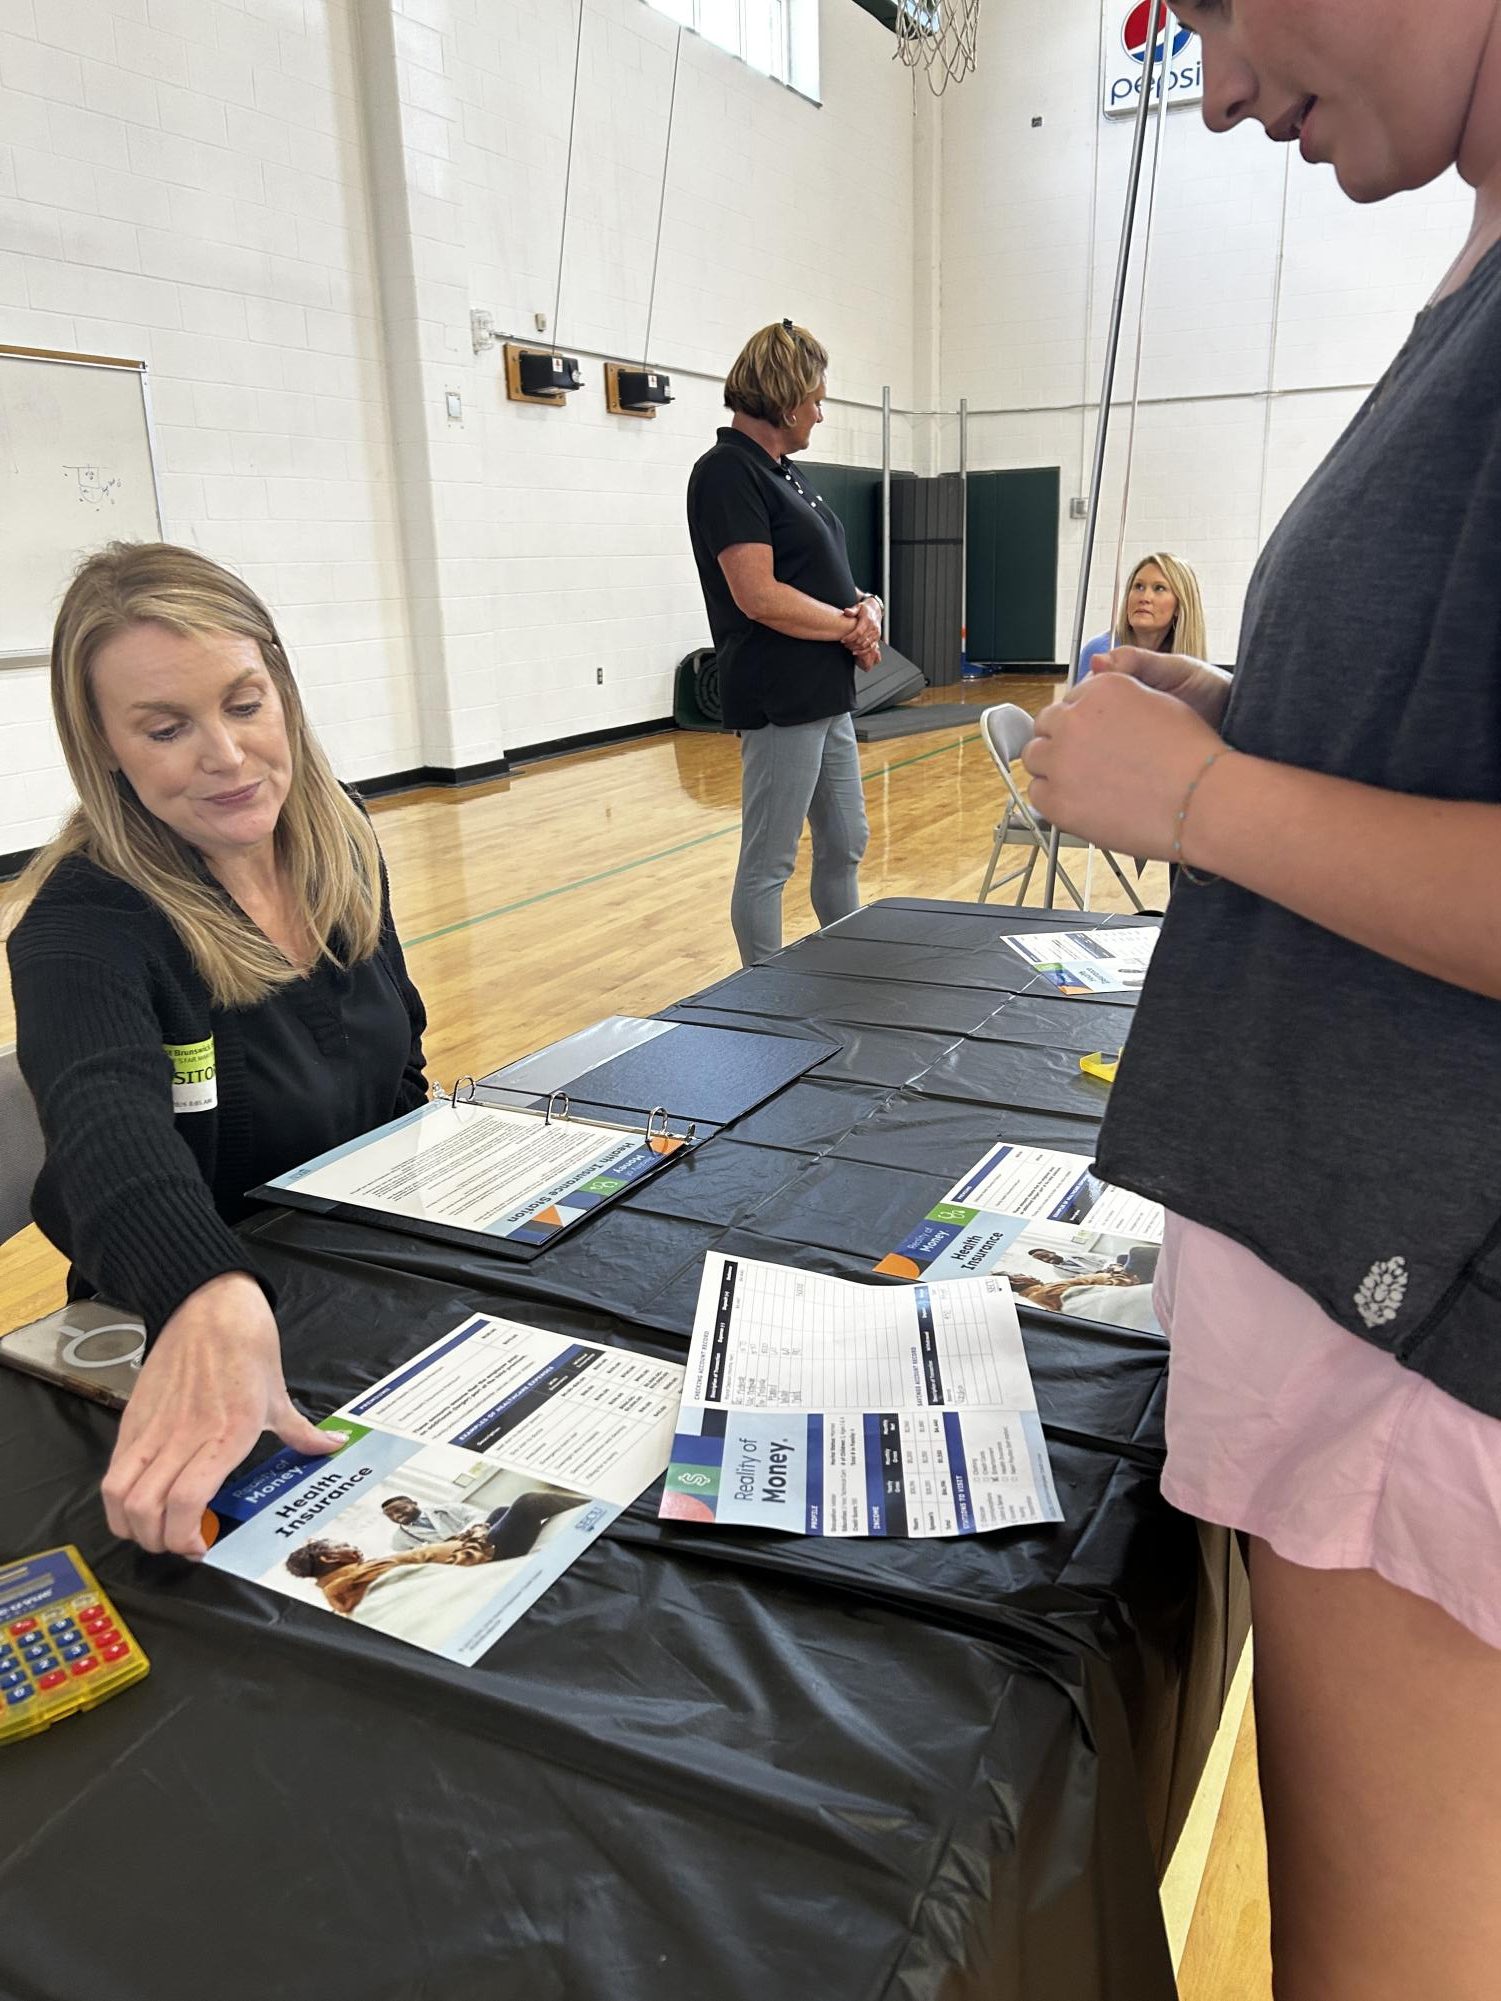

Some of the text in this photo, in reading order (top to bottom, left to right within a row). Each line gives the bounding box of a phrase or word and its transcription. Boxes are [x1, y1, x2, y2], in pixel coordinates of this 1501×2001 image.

[1111, 61, 1201, 105] pepsi
[507, 1142, 636, 1223] Health Insurance Station
[950, 1235, 983, 1260] Health
[960, 1232, 1004, 1270] Insurance
[701, 1330, 709, 1350] RECORD
[698, 1351, 706, 1374] ACCOUNT
[734, 1438, 761, 1501] Reality of
[275, 1473, 342, 1518] Health
[275, 1467, 373, 1538] Insurance
[958, 1493, 965, 1501] TO
[810, 1505, 818, 1529] PROFILE
[872, 1506, 880, 1529] INCOME
